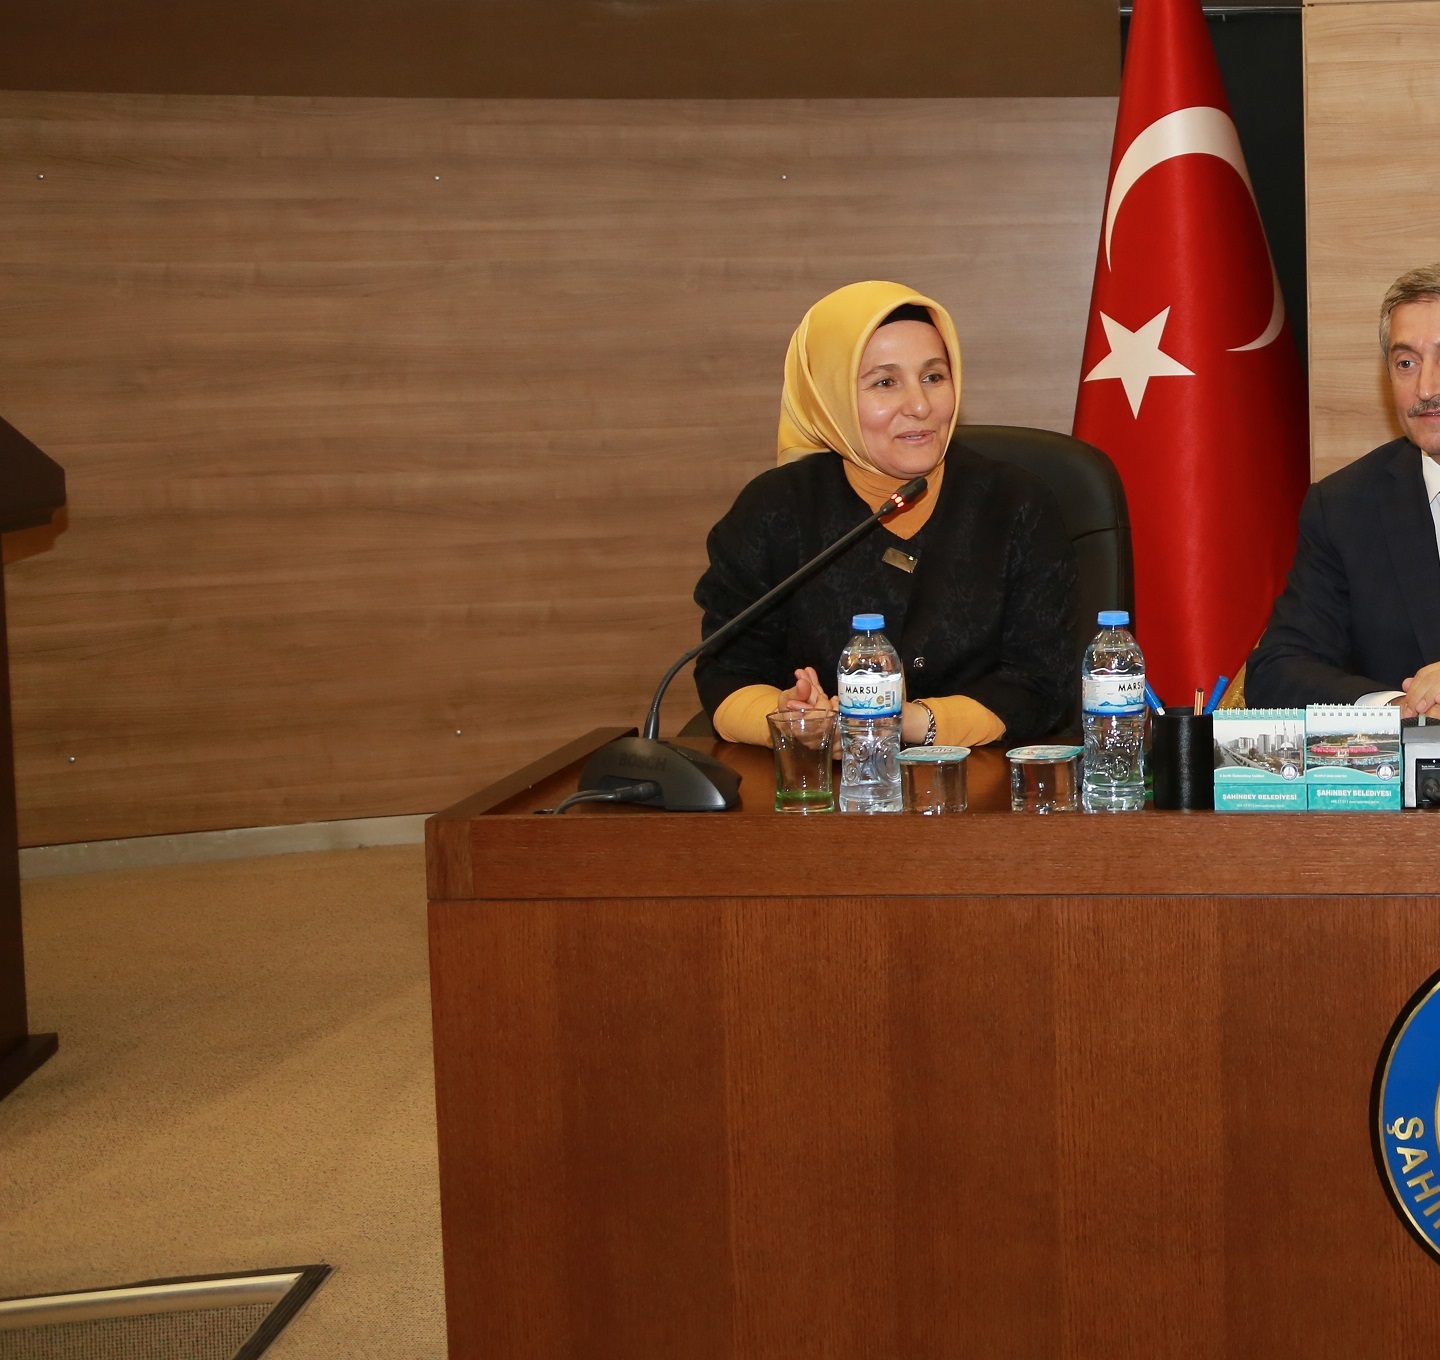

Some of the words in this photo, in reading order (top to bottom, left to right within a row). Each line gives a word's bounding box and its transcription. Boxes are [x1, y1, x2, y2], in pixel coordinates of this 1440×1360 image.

[845, 685, 878, 695] MARSU
[618, 753, 668, 772] BOSCH
[1222, 792, 1257, 801] ŞAHİNBEY
